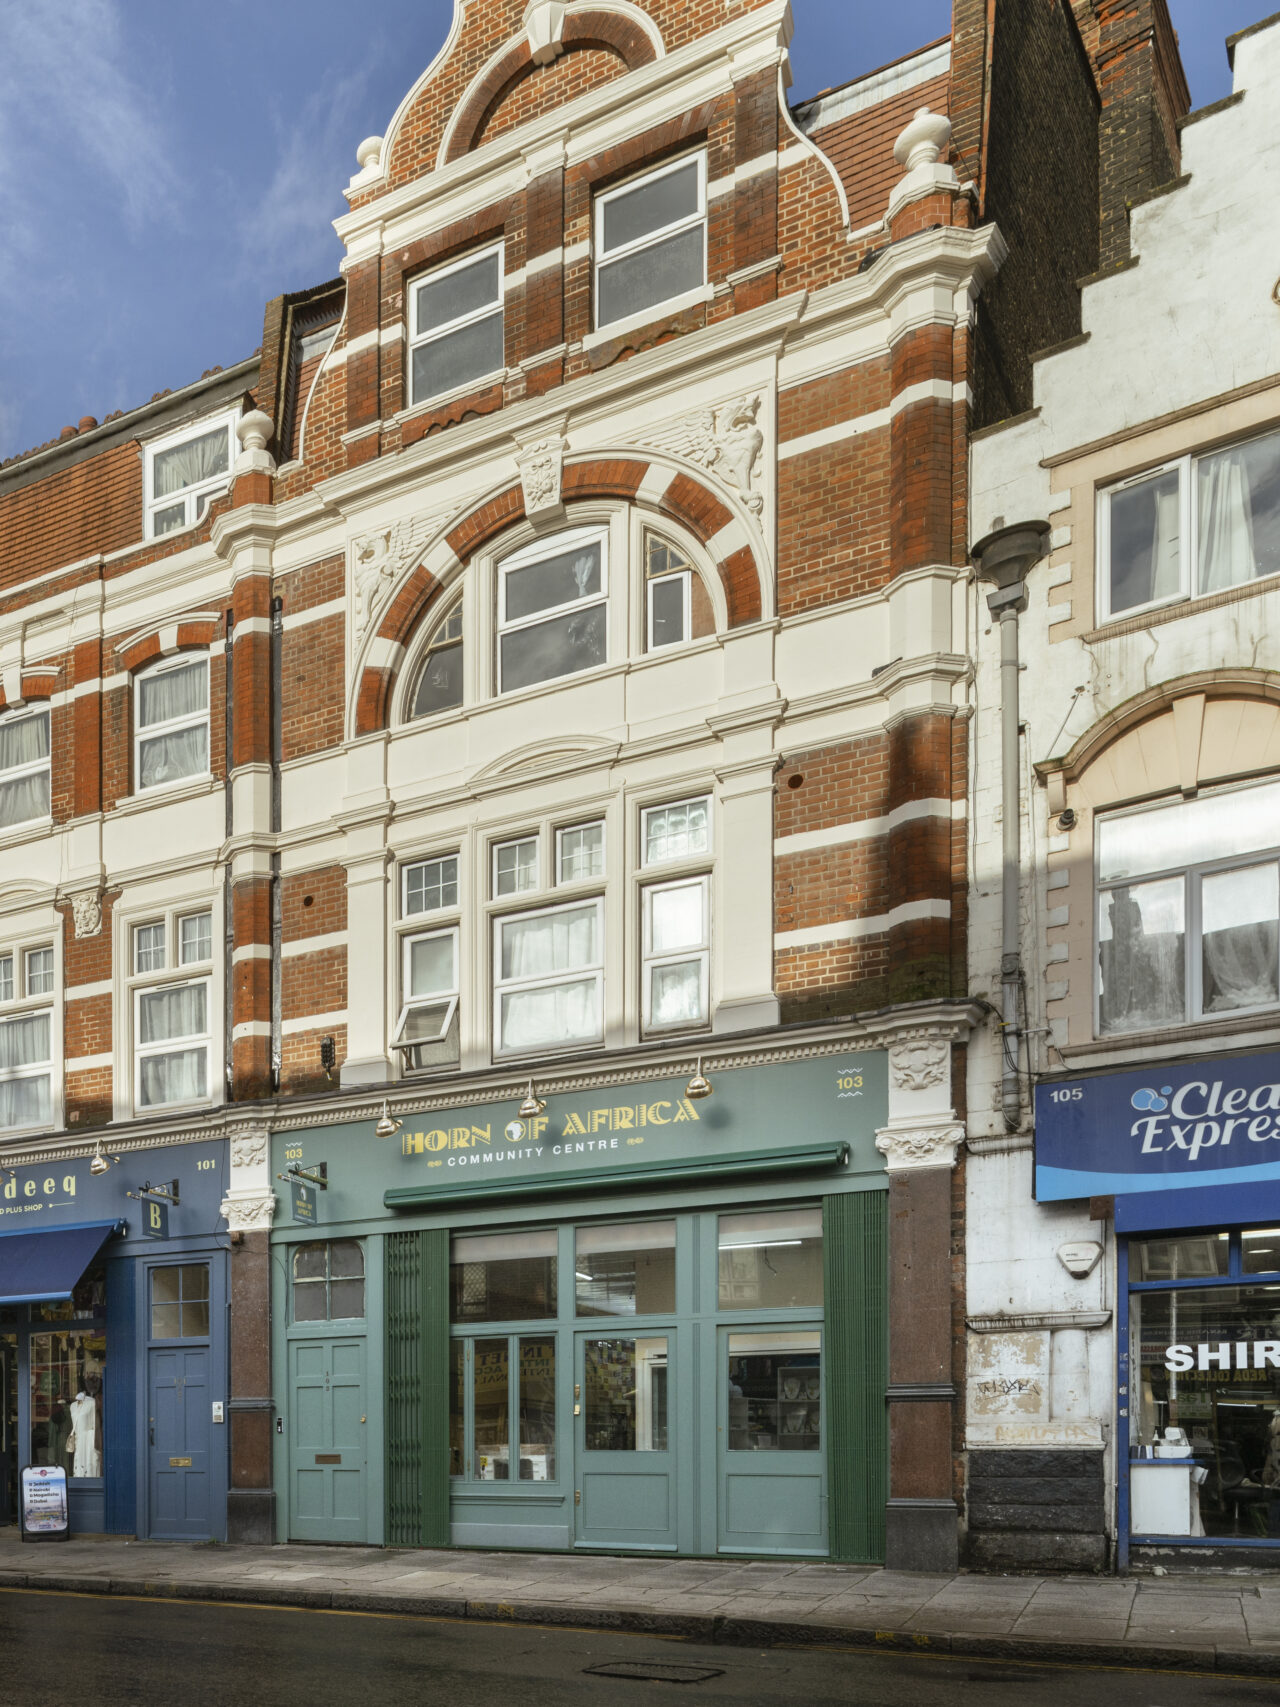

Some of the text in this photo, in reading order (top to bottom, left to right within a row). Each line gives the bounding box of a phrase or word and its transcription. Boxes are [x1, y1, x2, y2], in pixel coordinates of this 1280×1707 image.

[836, 1075, 864, 1090] 103
[1049, 1087, 1084, 1103] 105
[402, 1098, 701, 1155] HORN OF AFRICA
[284, 1148, 303, 1160] 103
[447, 1138, 619, 1167] COMMUNITY CENTRE
[196, 1159, 216, 1171] 101
[6, 1206, 23, 1214] PLUS
[24, 1203, 44, 1212] SHOP
[149, 1202, 161, 1229] B
